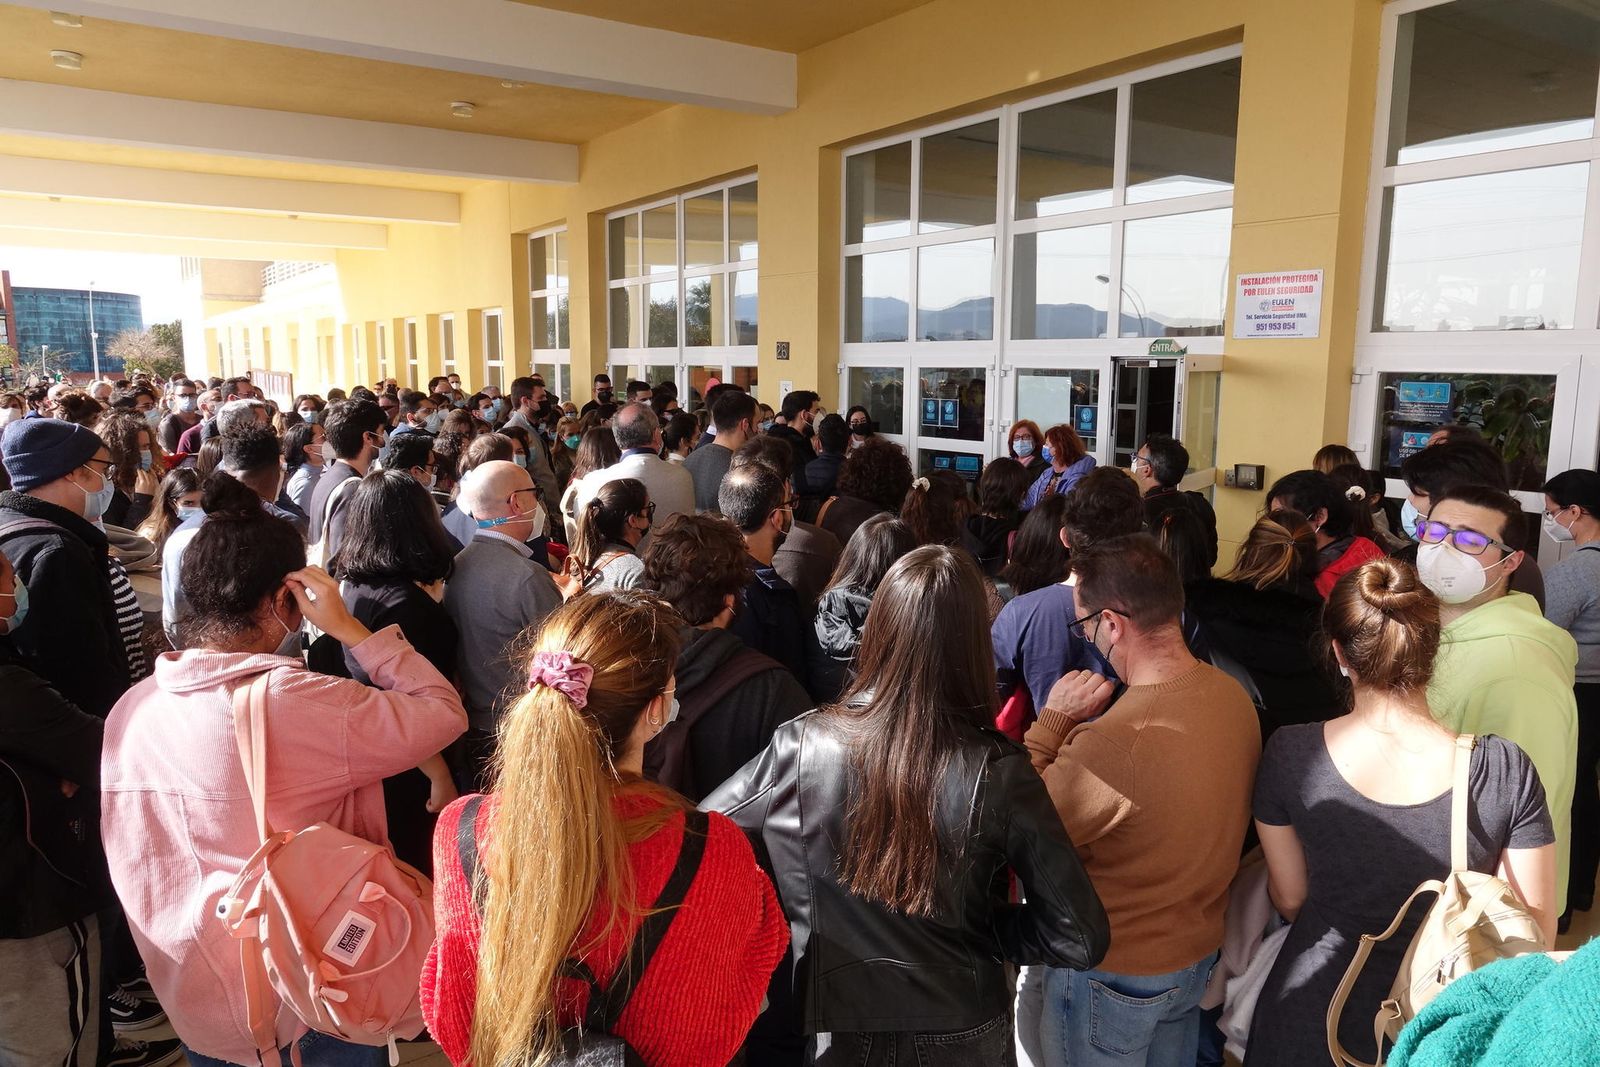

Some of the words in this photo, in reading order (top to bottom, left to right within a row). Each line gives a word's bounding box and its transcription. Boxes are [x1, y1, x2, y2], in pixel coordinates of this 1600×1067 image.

[1240, 276, 1281, 286] INSTALACIÓN
[1282, 274, 1318, 283] PROTEGIDA
[1243, 288, 1256, 296] POR
[1257, 287, 1275, 296] EULEN
[1276, 286, 1313, 295] SEGURIDAD
[1272, 298, 1295, 306] EULEN
[1256, 323, 1268, 331] 951
[1268, 322, 1282, 330] 953
[1282, 322, 1296, 330] 054
[777, 343, 788, 358] 26
[1151, 343, 1183, 352] ENTRA
[339, 925, 357, 948] LIMITED
[346, 928, 366, 953] EDITION
